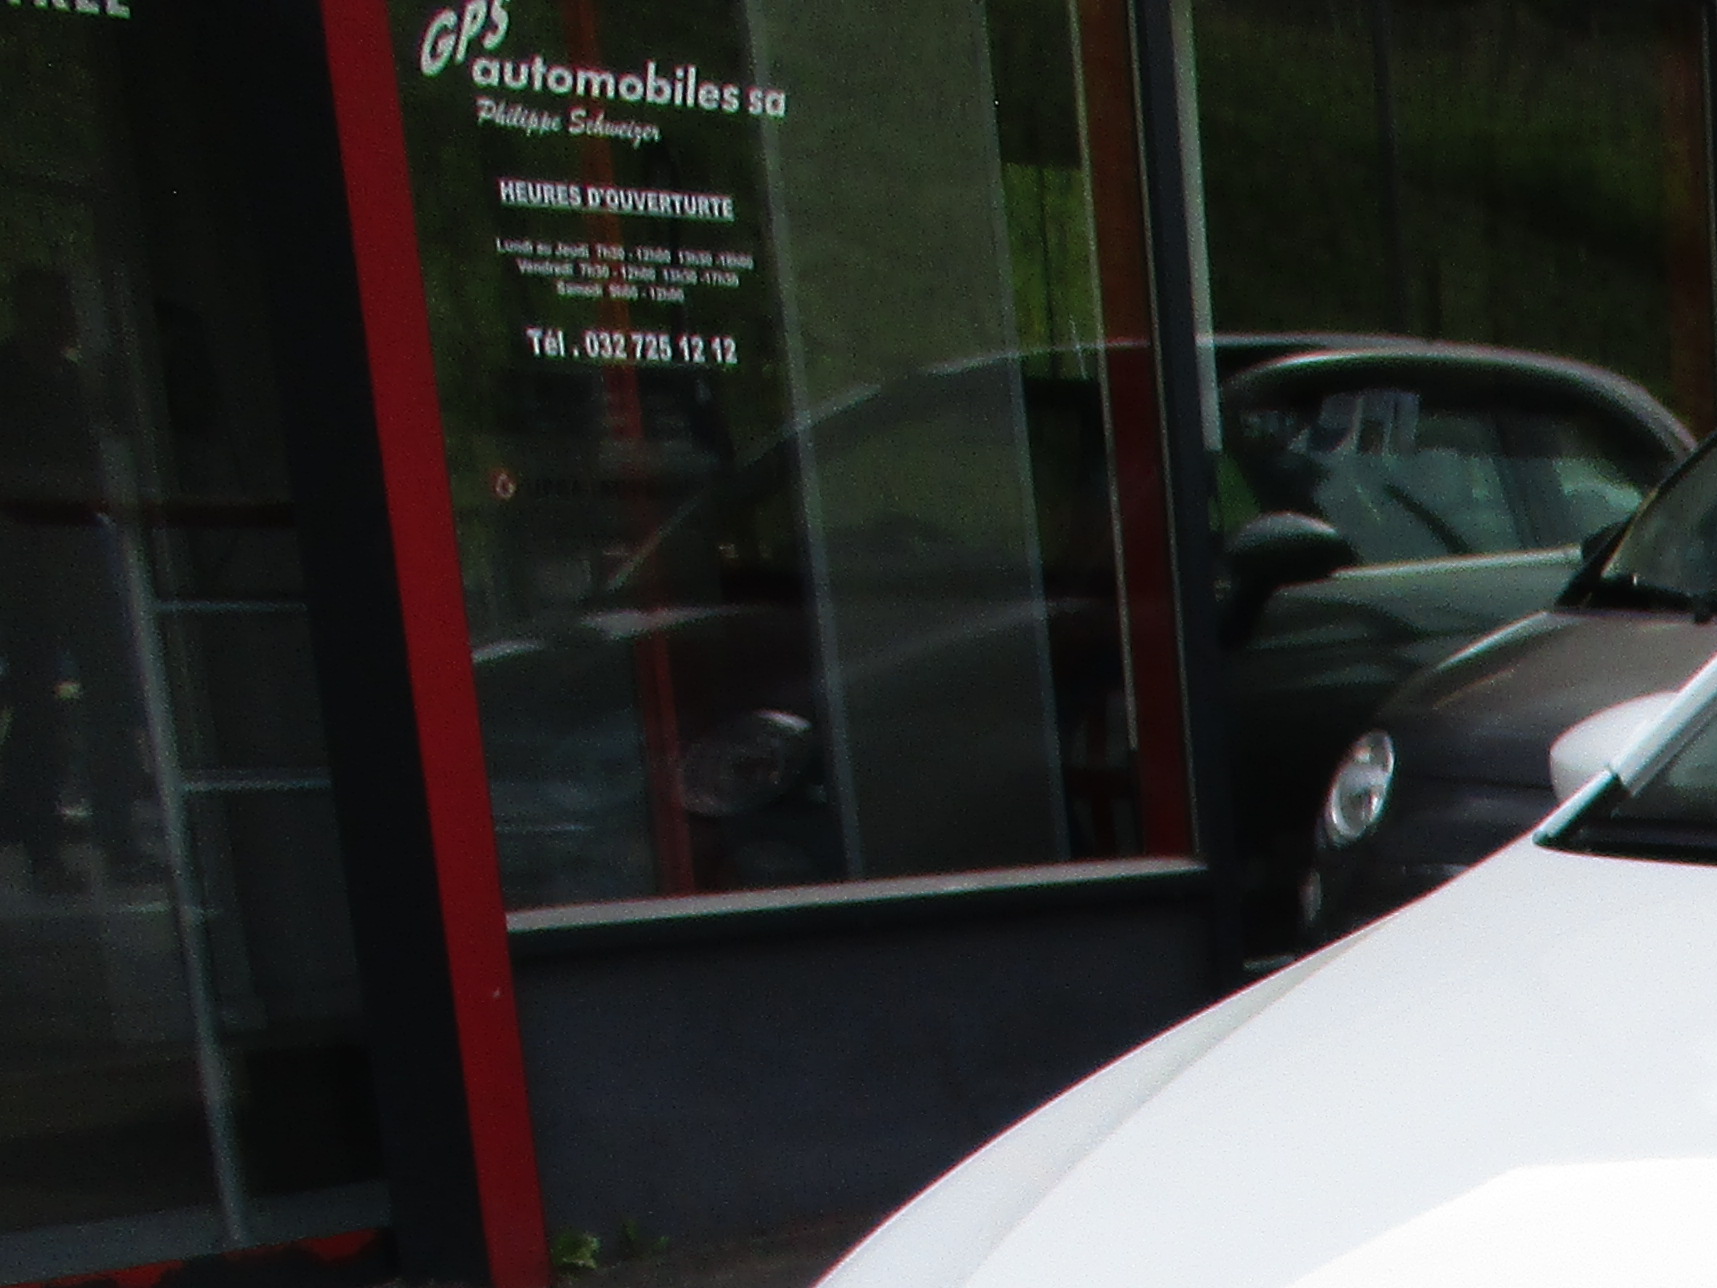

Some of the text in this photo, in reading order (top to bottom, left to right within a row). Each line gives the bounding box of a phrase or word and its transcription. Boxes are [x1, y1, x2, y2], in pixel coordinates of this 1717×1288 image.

[420, 0, 510, 76] GPS
[471, 55, 787, 118] automobiles sa
[475, 97, 661, 149] Philippe Schweizer
[499, 178, 583, 207] HEURES
[526, 327, 565, 358] Tél
[585, 330, 628, 359] 032
[631, 332, 673, 362] 725
[679, 335, 706, 364] 12
[711, 336, 738, 365] 12
